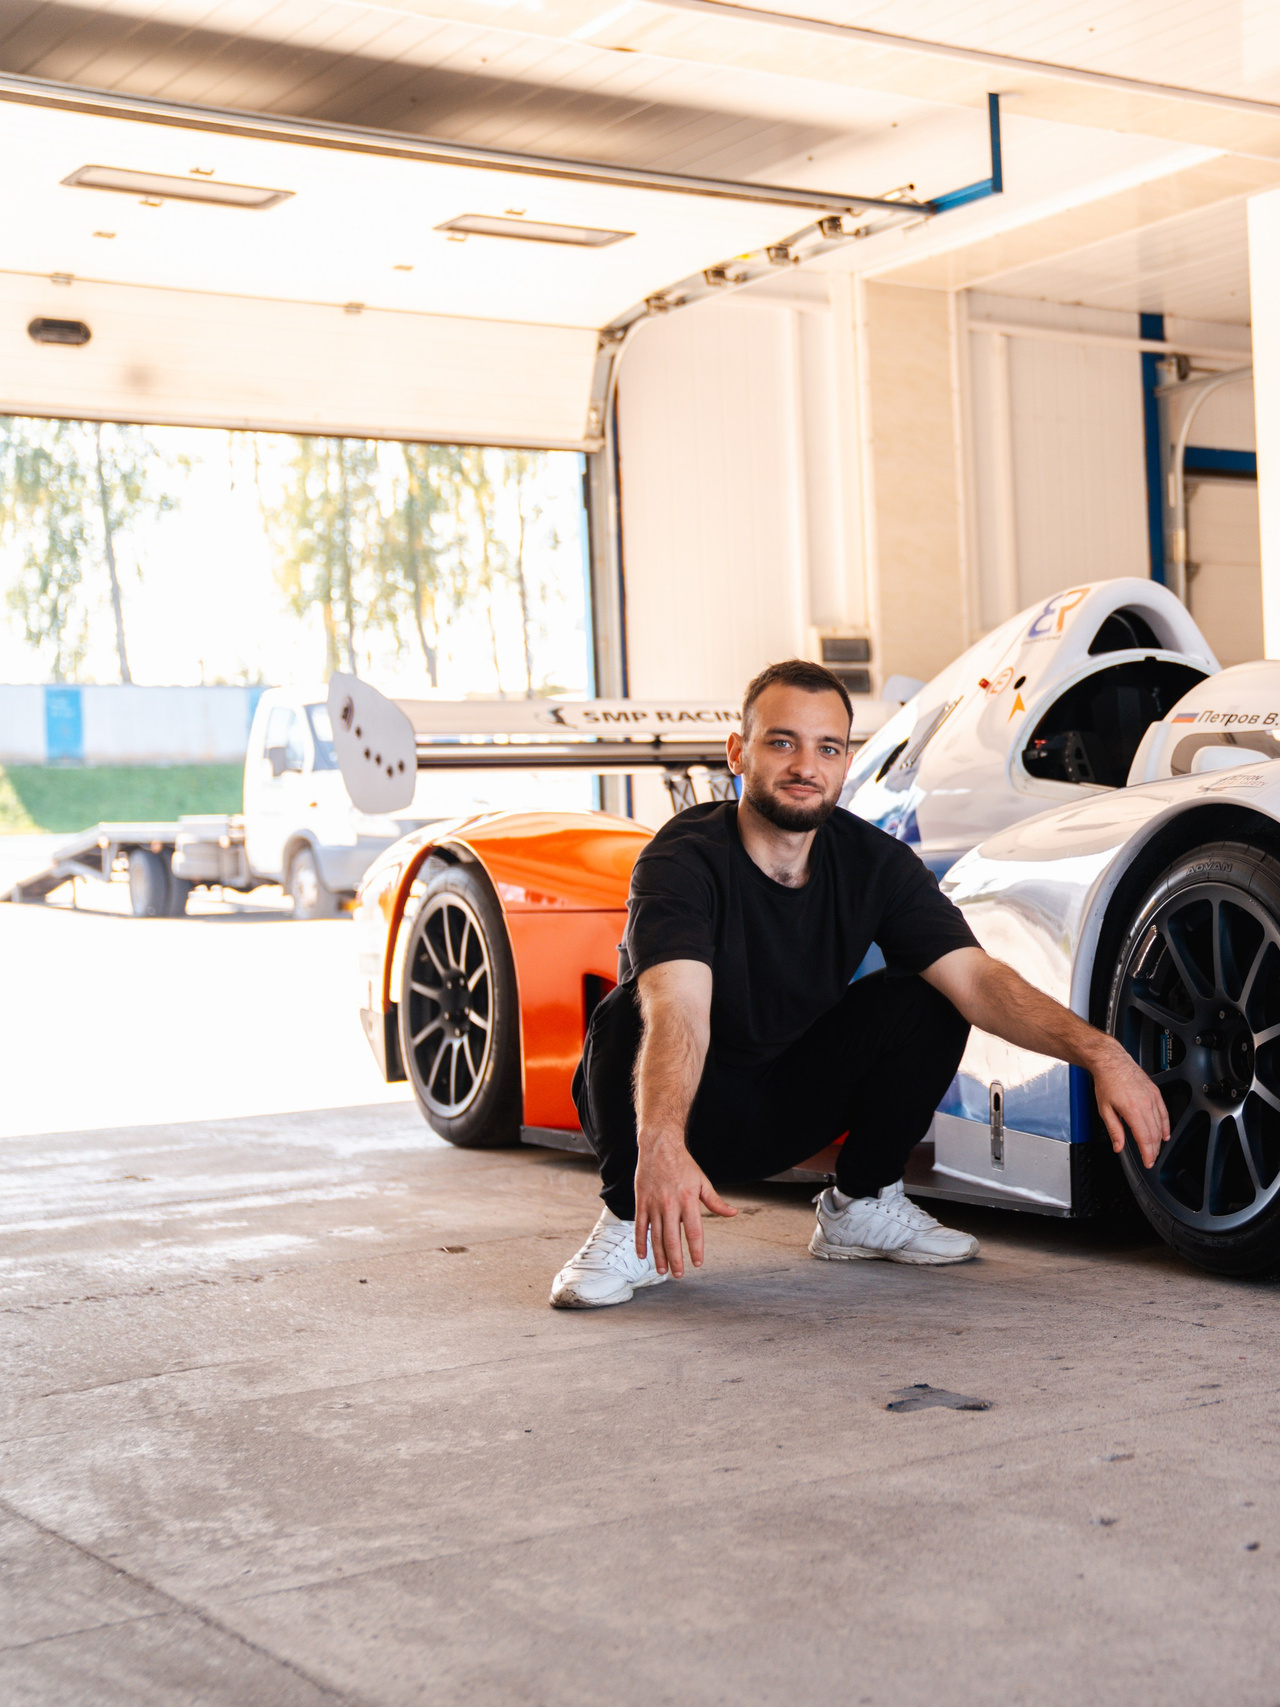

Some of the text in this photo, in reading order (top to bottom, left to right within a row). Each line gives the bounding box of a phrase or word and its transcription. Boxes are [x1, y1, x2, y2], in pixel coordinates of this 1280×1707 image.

[583, 710, 743, 723] SMP RACIN
[1198, 710, 1279, 726] Петров В.
